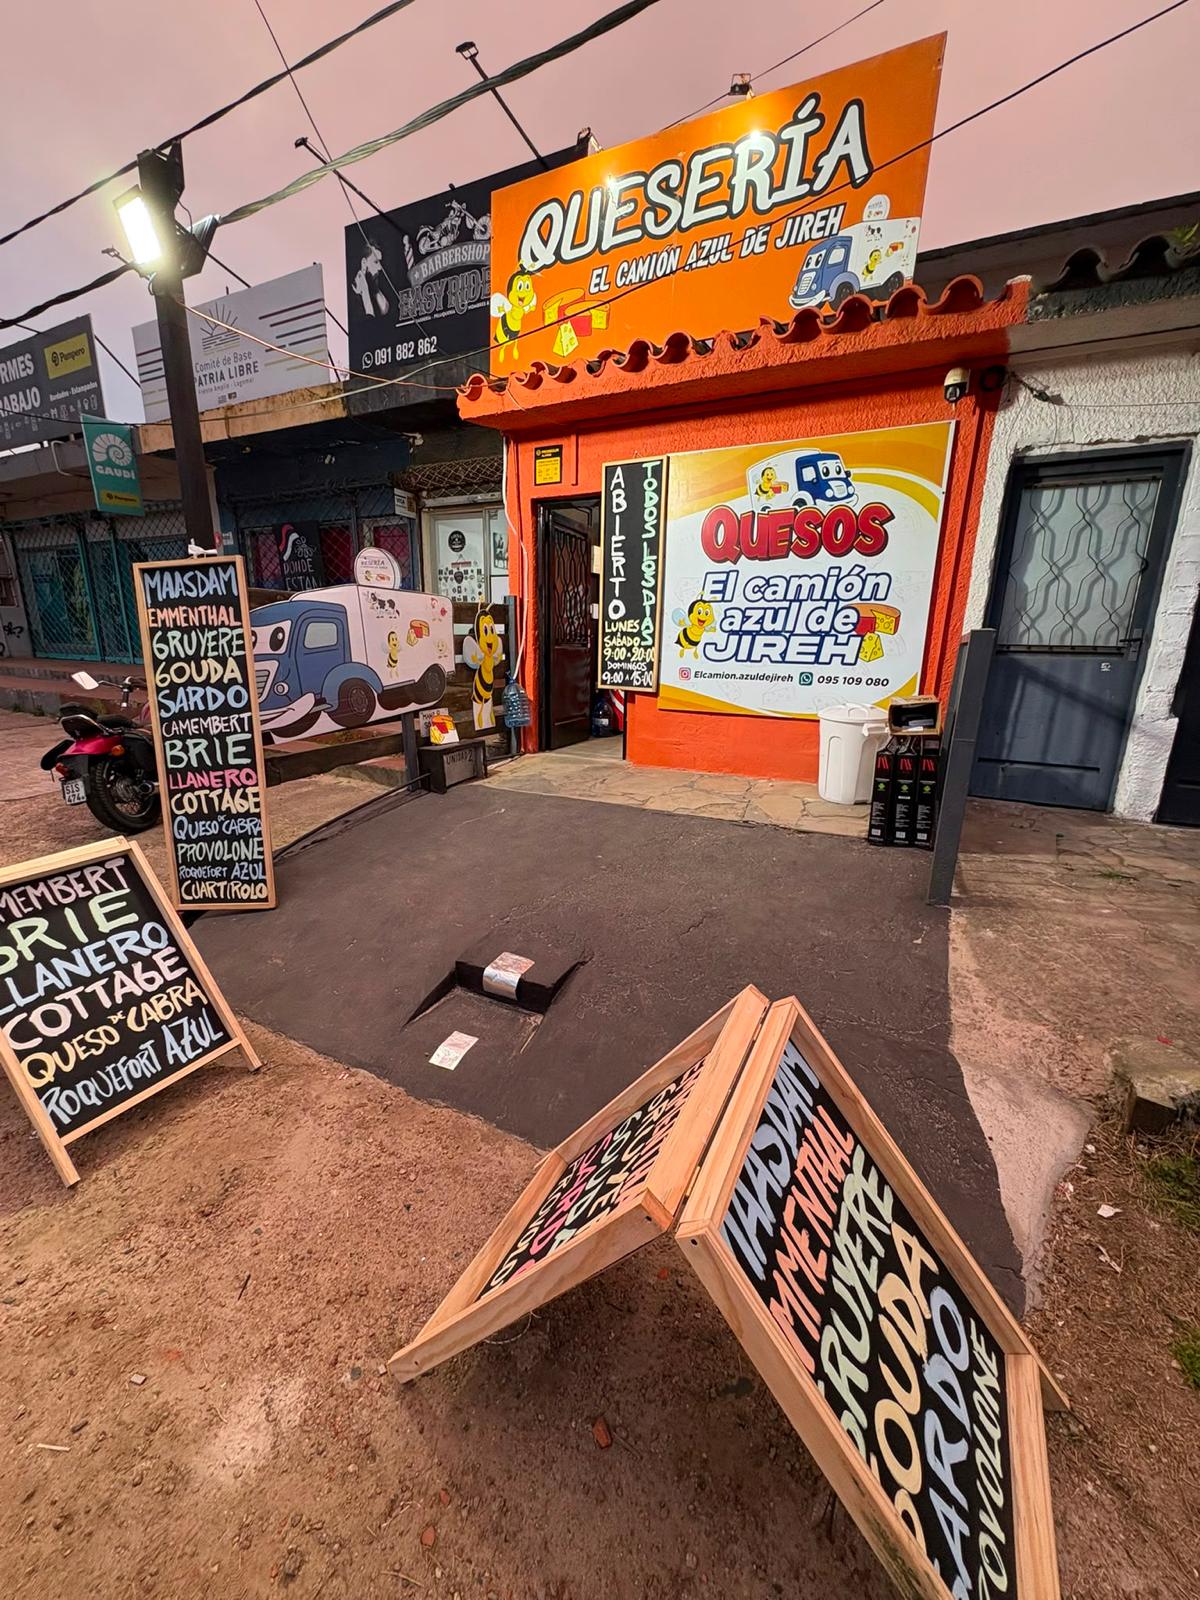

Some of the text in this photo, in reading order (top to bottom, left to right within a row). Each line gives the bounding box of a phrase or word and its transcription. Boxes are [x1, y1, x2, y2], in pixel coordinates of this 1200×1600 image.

[517, 92, 873, 273] QUESERÍA
[420, 243, 490, 278] BARBERSHOP
[588, 202, 847, 295] EL CAMIÓN AZUL DE JIREH
[195, 351, 252, 373] Comité de Base
[374, 336, 437, 366] 091 882 862
[0, 353, 34, 384] RMES
[228, 361, 260, 380] LIBRE
[642, 461, 661, 539] TODOS
[608, 466, 628, 620] ABIERTO
[701, 502, 895, 565] QUESOS
[144, 565, 239, 607] MAASDAM
[702, 564, 891, 602] El camión
[148, 605, 242, 628] EMMENTHAL
[605, 619, 640, 633] LUNES
[720, 602, 860, 635] azul de
[603, 647, 626, 661] 9:00
[630, 646, 655, 662] 20:00
[604, 635, 640, 647] SABADO
[703, 632, 864, 666] JIREH
[602, 671, 624, 684] 9:00
[630, 671, 653, 686] 15:00
[694, 670, 793, 683] Elcamion.azuldejireh
[817, 675, 889, 687] 095 109 080
[158, 685, 249, 718] SARDO
[162, 712, 252, 737] CAMEMBERT
[164, 733, 252, 769] BRIE
[169, 767, 257, 790] LLANERO
[173, 815, 219, 840] QUESO
[222, 817, 262, 836] CABRA
[177, 838, 264, 864] PROVOLONE
[179, 862, 266, 881] ROQUEFORT AZUL
[181, 880, 268, 900] CUARTIROLO
[19, 1023, 120, 1089] QUESO
[126, 977, 209, 1033] CABRA
[40, 1007, 225, 1127] ROQUEFORT AZUL
